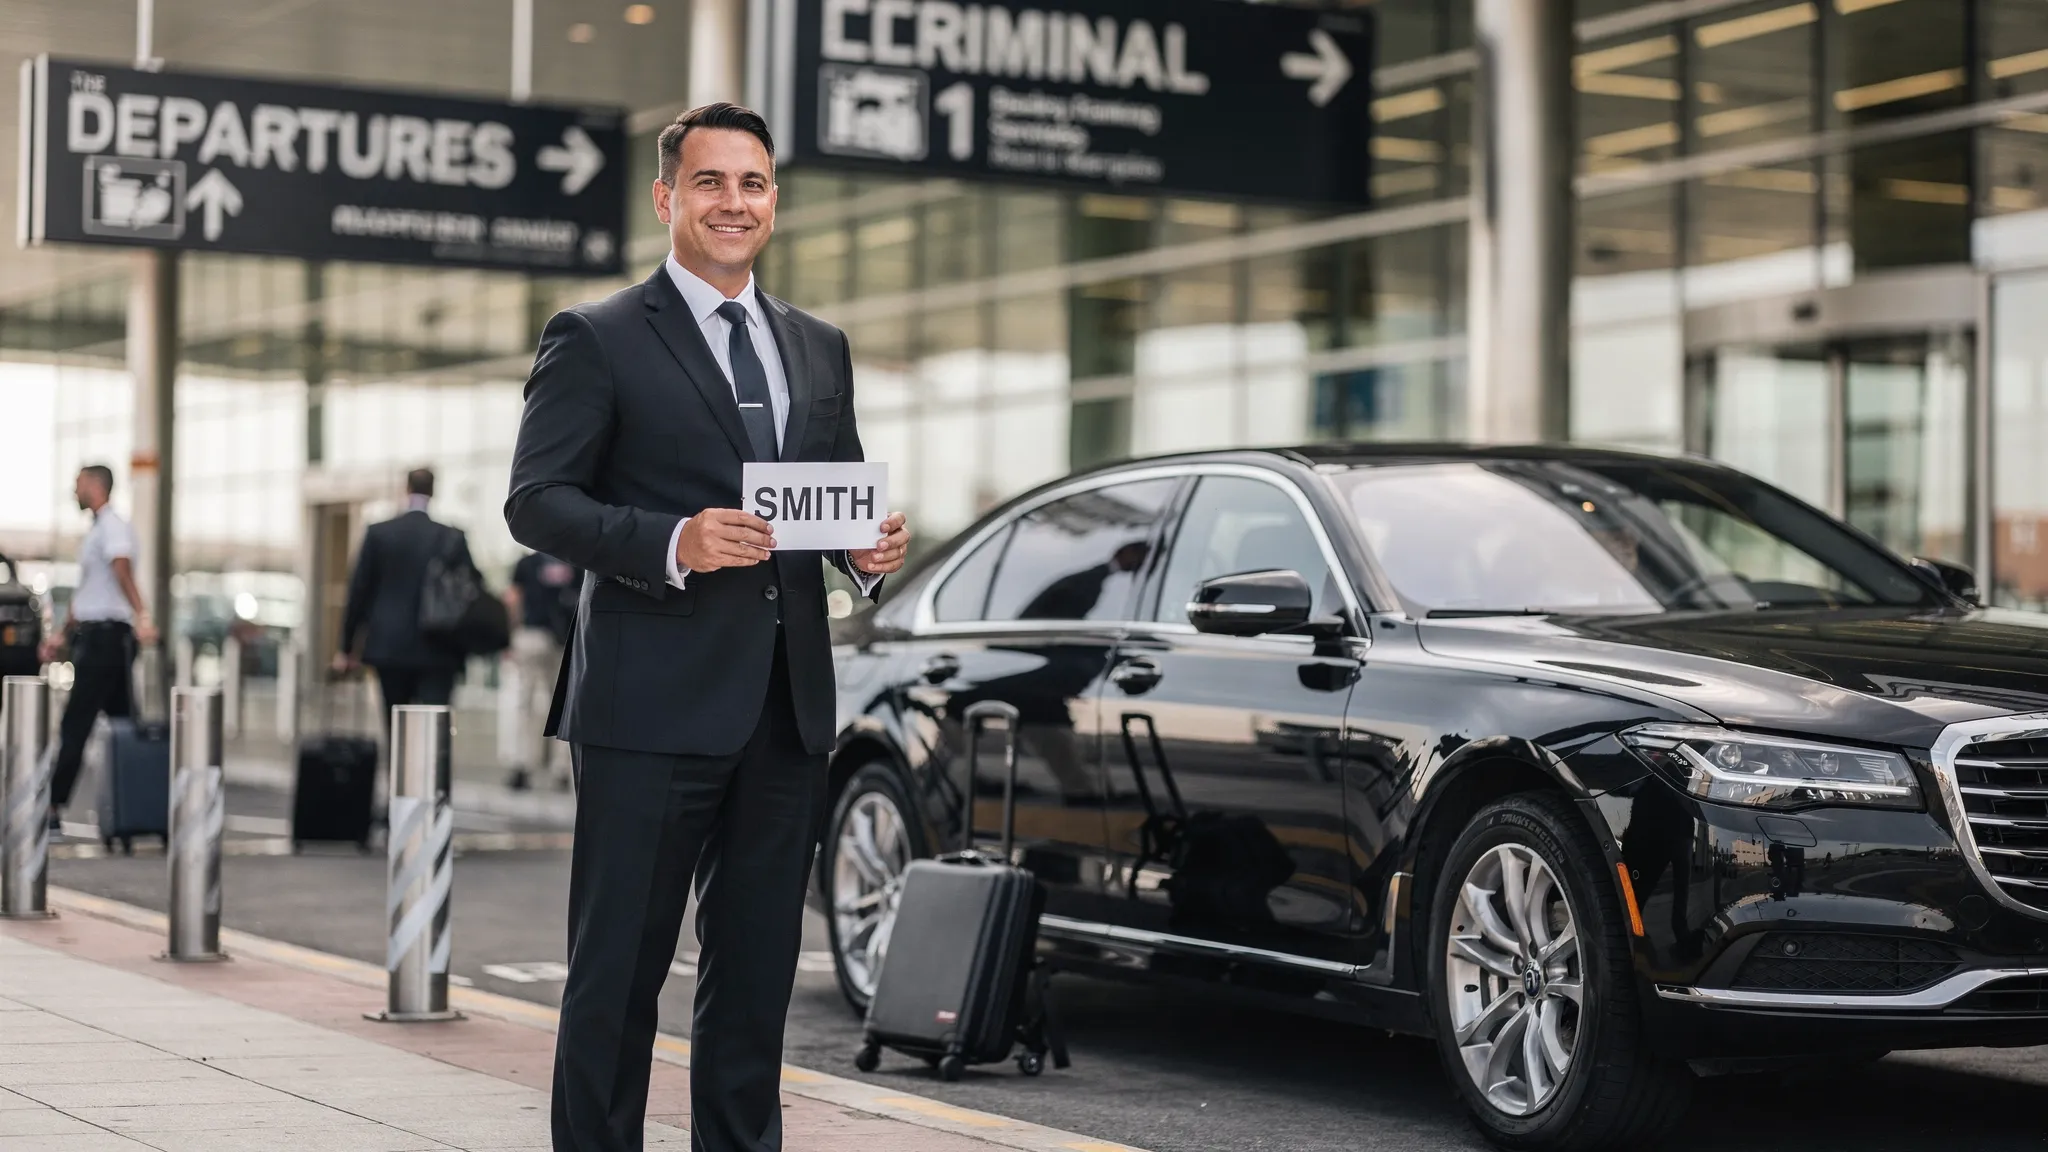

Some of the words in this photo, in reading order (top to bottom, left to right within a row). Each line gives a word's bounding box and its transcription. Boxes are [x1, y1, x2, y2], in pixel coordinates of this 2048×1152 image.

[67, 92, 517, 189] DEPARTURES
[934, 82, 976, 161] 1
[754, 486, 875, 522] SMITH
